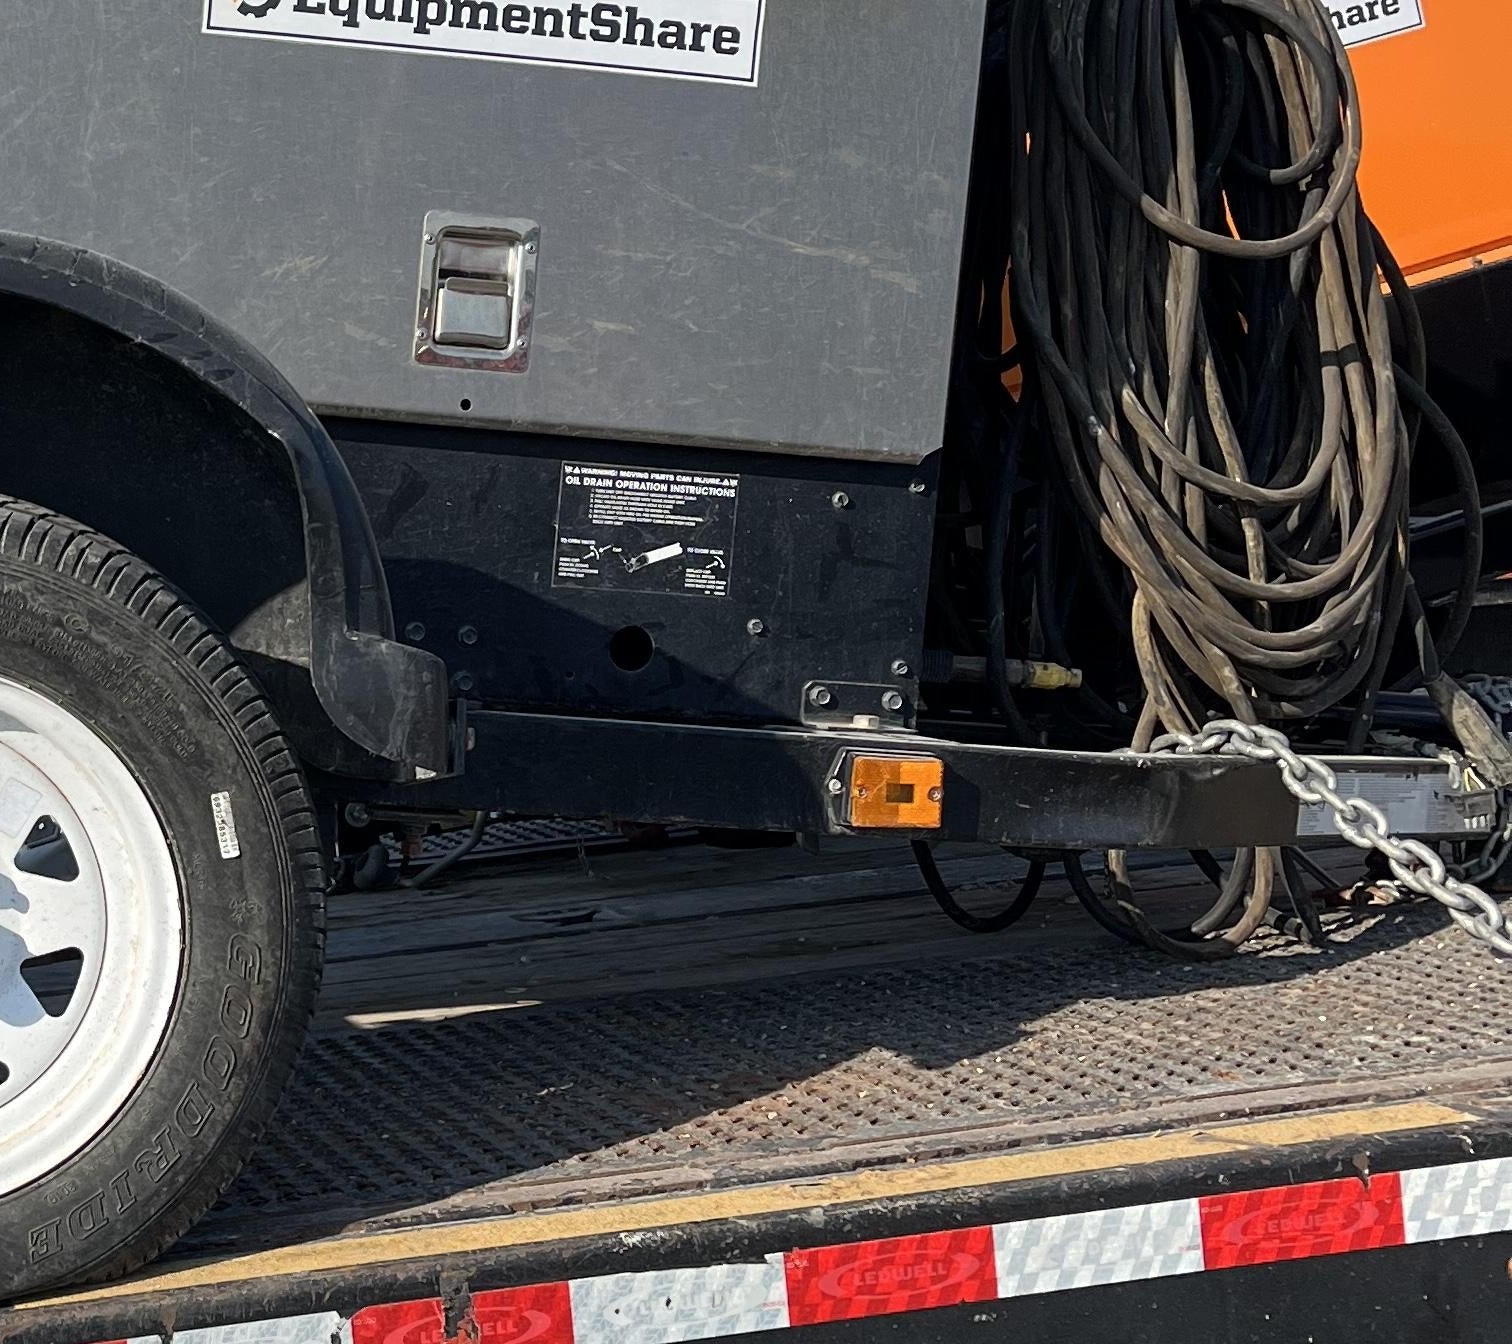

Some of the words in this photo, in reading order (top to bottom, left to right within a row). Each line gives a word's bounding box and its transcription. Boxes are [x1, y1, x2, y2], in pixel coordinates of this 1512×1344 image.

[565, 475, 581, 486] OIL
[583, 477, 613, 488] DRAIN
[615, 480, 668, 493] OPERATION
[670, 484, 736, 498] INSTRUCTIONS
[27, 931, 263, 1265] GOODRIDE
[853, 1260, 948, 1288] LEDWELL
